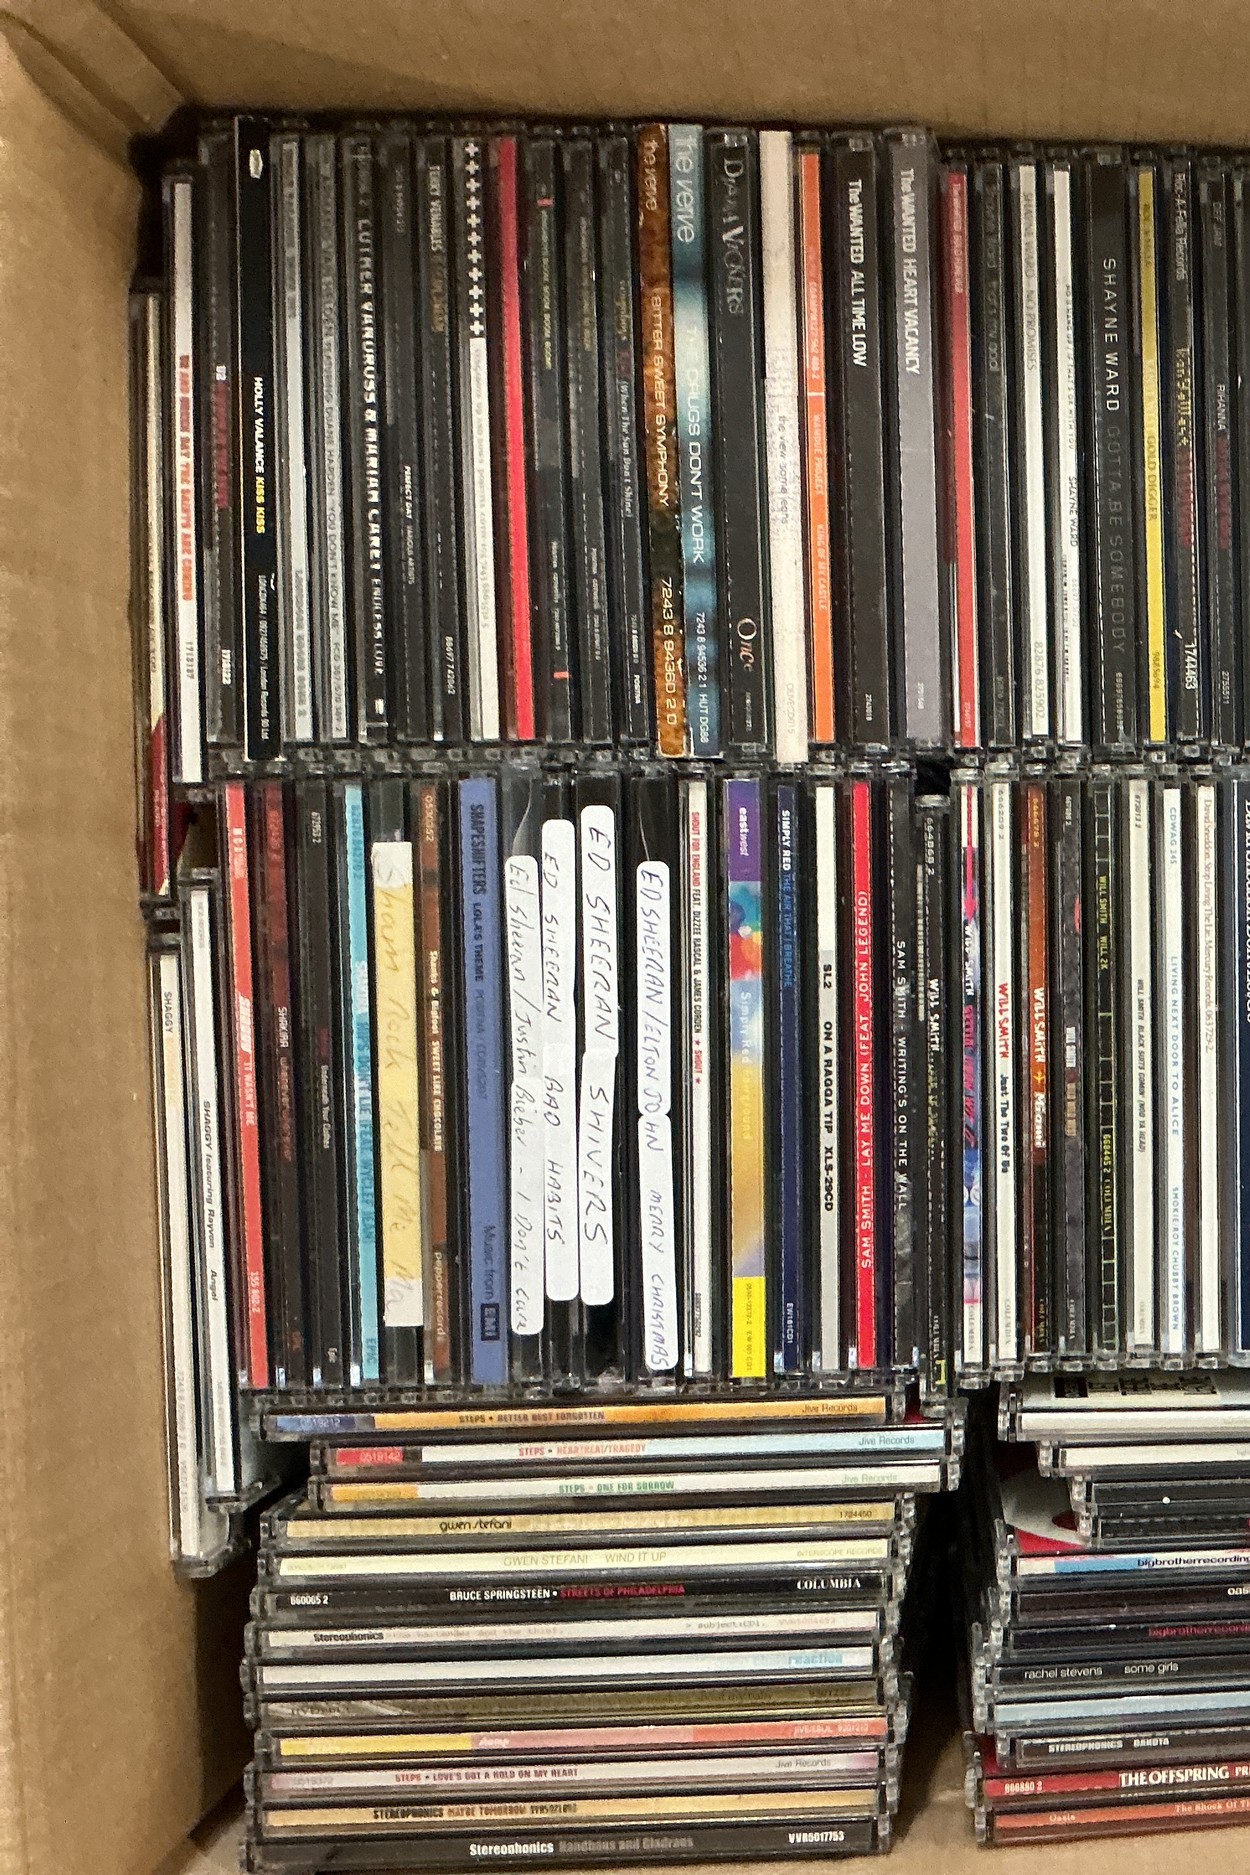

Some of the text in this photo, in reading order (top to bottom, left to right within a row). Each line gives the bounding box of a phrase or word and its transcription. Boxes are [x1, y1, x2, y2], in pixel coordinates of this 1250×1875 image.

[850, 270, 866, 293] ALL
[903, 259, 918, 306] HEART
[851, 296, 866, 330] TIME
[1103, 259, 1120, 411] SHAYNE WARD
[852, 334, 867, 366] LOW
[905, 309, 920, 374] VACANCY
[650, 296, 669, 506] BITTER SWEET SYMPHONY
[253, 377, 266, 533] HOLLY VALANCE KISS KISS
[689, 443, 704, 499] DON'T
[691, 505, 706, 563] WORK
[737, 618, 758, 672] Once
[1184, 642, 1197, 689] 1744463
[470, 804, 487, 895] SHAPESHIFTERS
[781, 810, 791, 870] SIMPLY RED
[473, 902, 484, 981] LOLA'S THEME
[543, 852, 561, 1022] ED SHEERAN
[586, 826, 612, 1040] ED SHEERAN
[857, 891, 869, 954] LEGEND)
[858, 961, 869, 999] JOHN
[822, 964, 834, 1211] SL2 ON A RAGGA TIP XLS-29CD
[859, 1061, 870, 1105] DOWN
[896, 941, 907, 1210] SAM SMITH WRITING'S ON THE WALL
[860, 1114, 871, 1135] ME
[543, 1076, 564, 1245] BAD HABITS
[584, 1085, 610, 1243] SHIVERS
[860, 1141, 871, 1167] LAY
[861, 1186, 871, 1235] SMITH
[861, 1243, 872, 1268] SAM
[450, 1589, 551, 1601] BRUCE SPRINGSTEEN
[797, 1579, 861, 1590] COLUMBIA
[1025, 1662, 1178, 1680] rachel stevens some girls
[470, 1842, 553, 1857] Stereophonics
